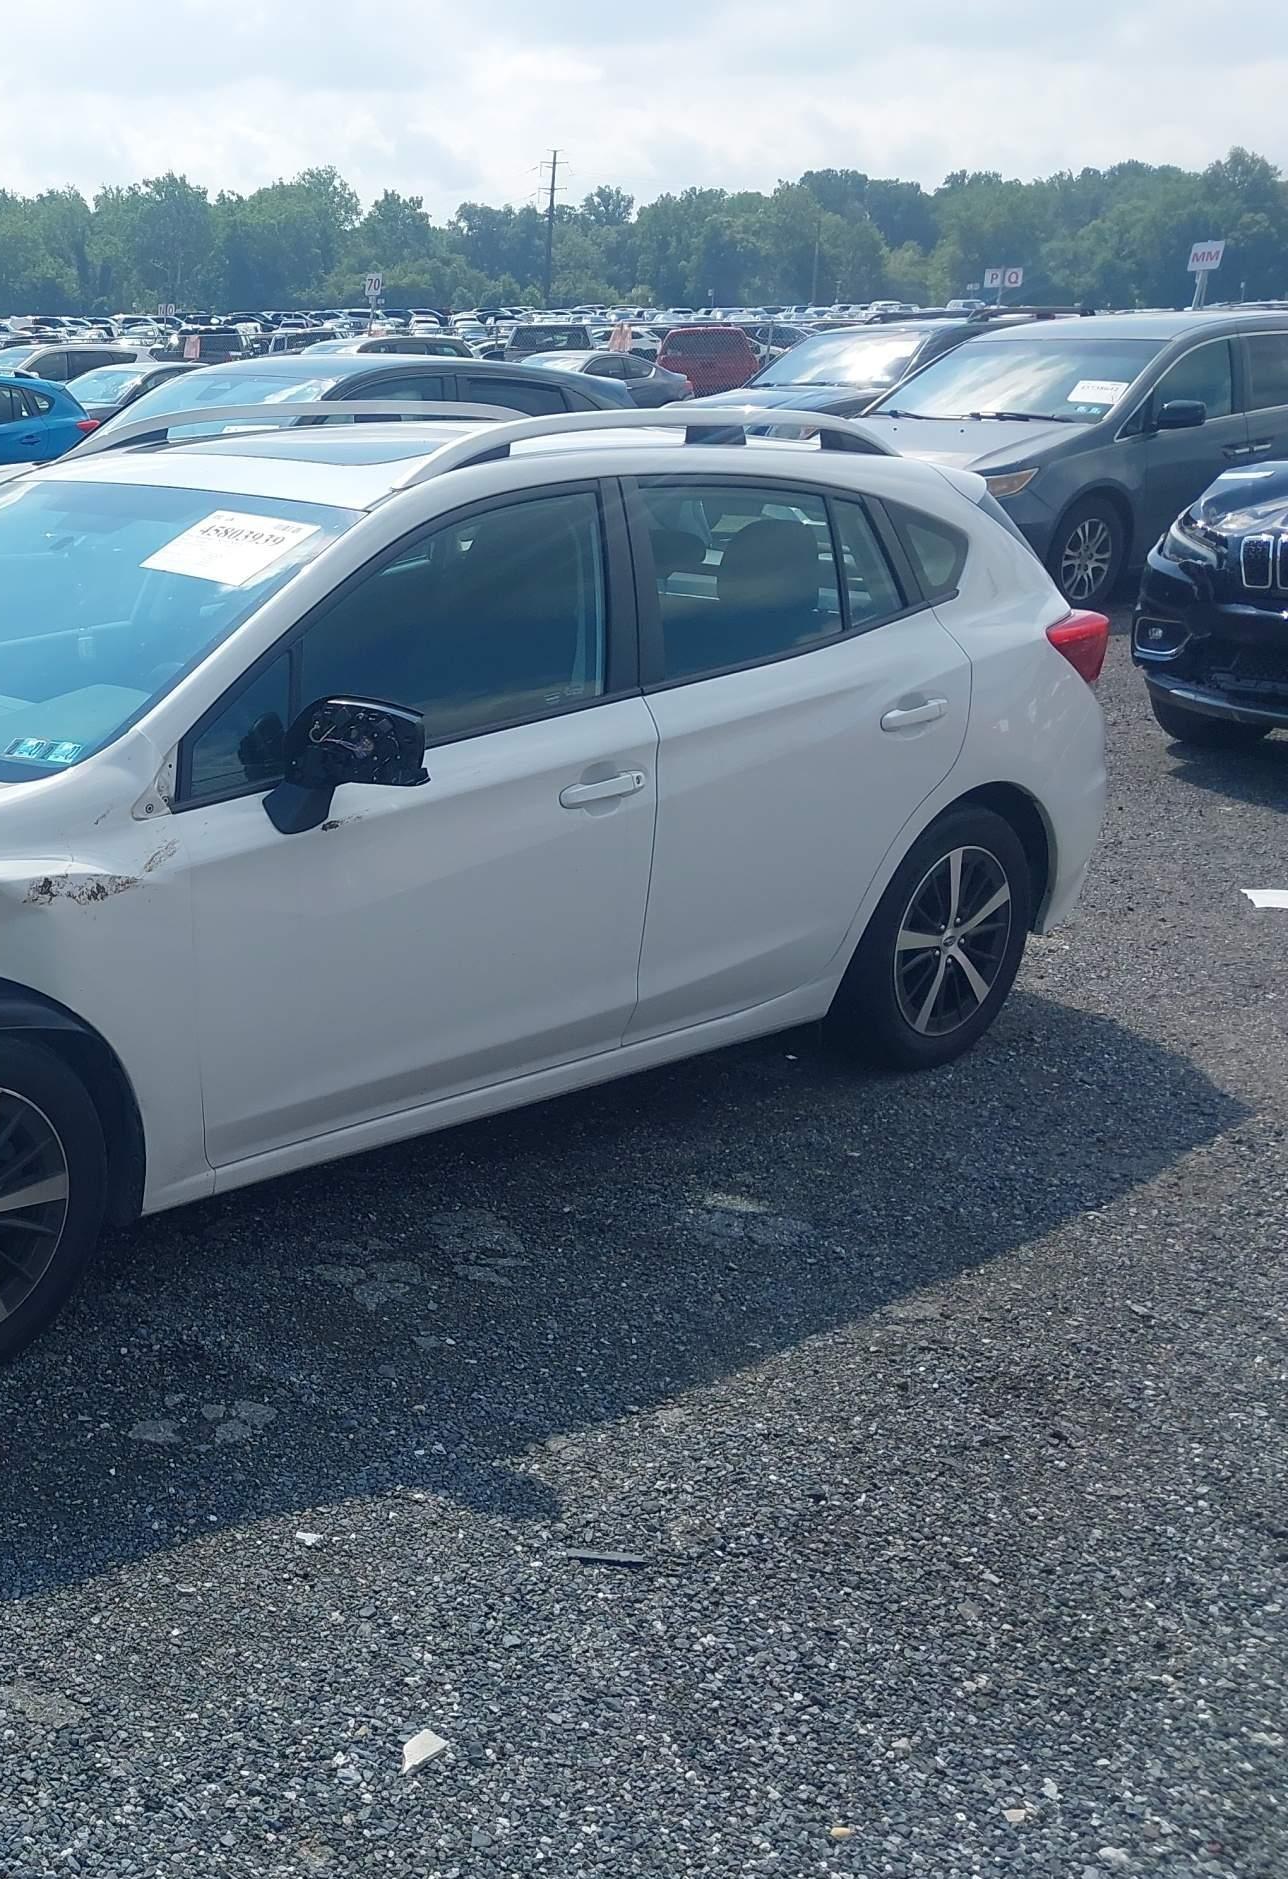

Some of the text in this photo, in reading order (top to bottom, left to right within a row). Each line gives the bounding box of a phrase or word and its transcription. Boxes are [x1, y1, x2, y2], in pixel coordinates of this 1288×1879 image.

[1192, 250, 1220, 263] MM
[990, 272, 999, 284] P
[1008, 271, 1019, 284] Q
[367, 278, 381, 291] 70
